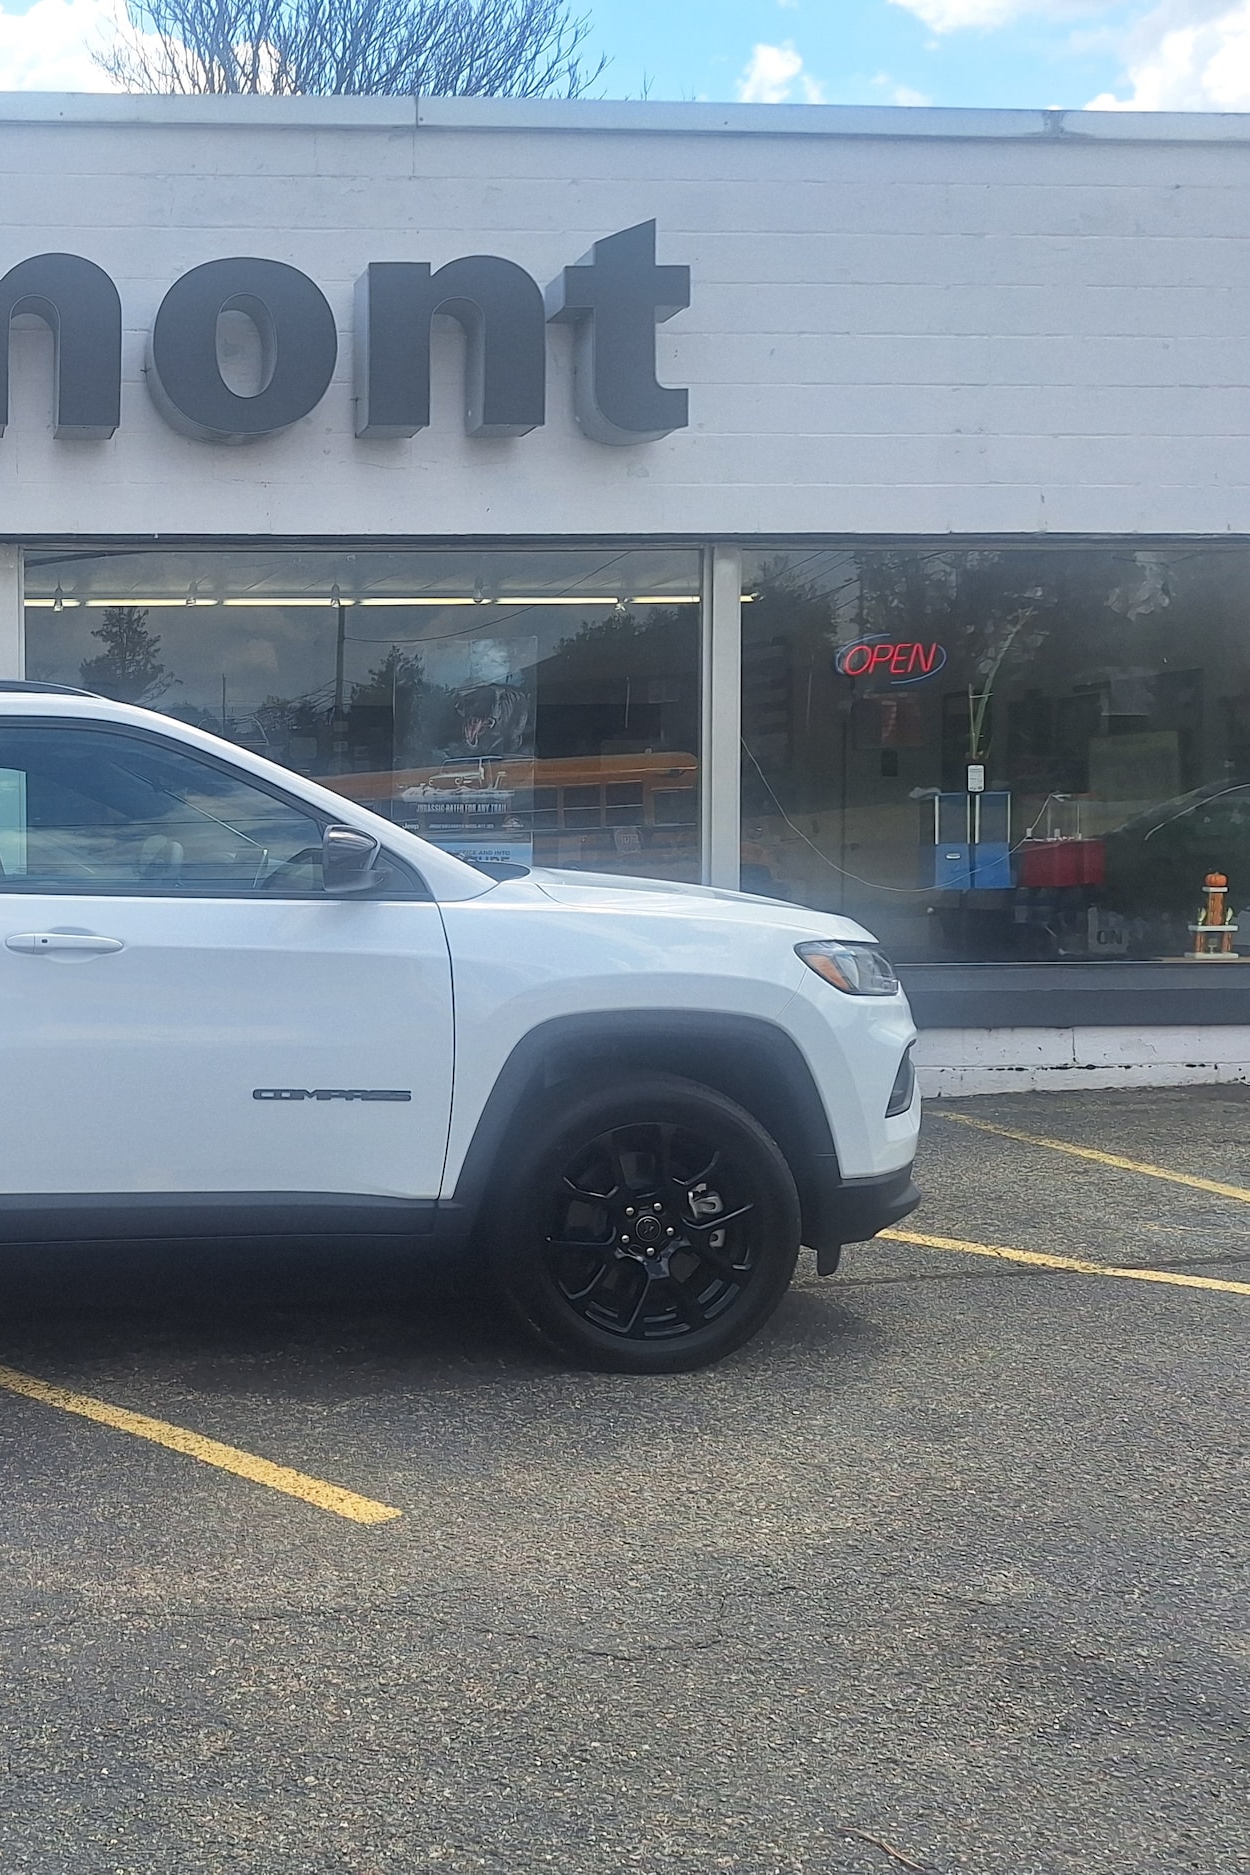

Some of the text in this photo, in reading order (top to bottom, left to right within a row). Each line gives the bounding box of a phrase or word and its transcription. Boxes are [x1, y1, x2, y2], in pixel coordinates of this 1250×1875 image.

[844, 642, 937, 676] OPEN
[402, 822, 420, 830] Jeep
[253, 1089, 411, 1101] COMPASS
